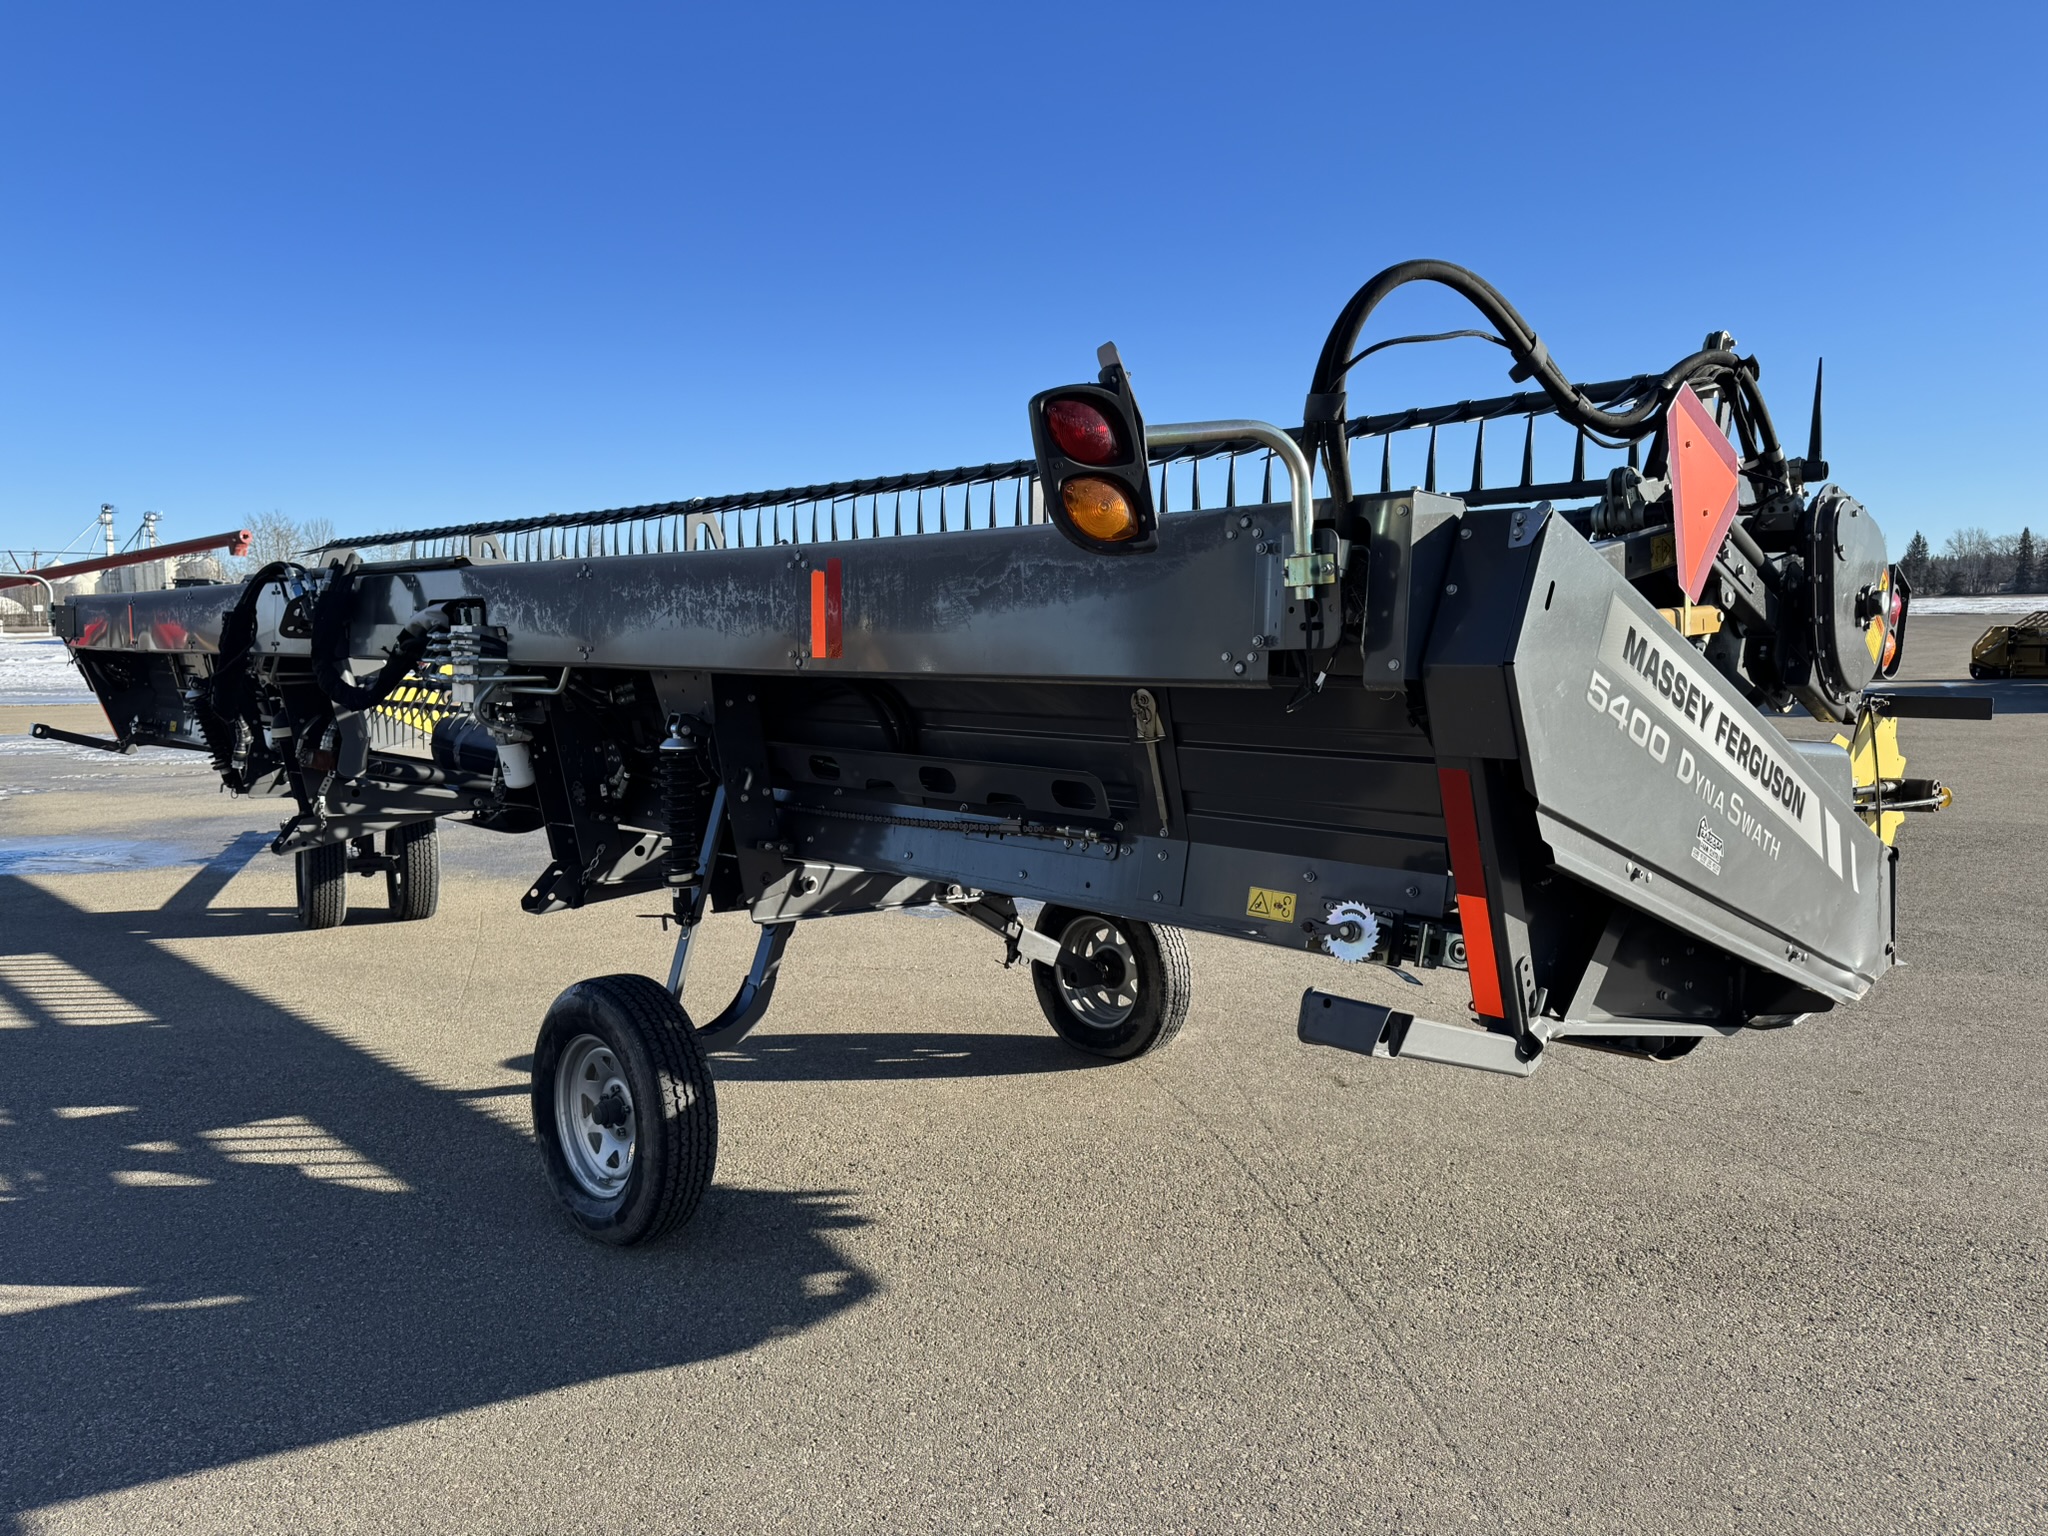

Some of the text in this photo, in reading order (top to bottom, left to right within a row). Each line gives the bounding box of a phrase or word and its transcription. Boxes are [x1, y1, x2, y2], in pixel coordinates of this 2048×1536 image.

[1586, 669, 1671, 764] 5400
[1622, 625, 1806, 823] MASSEY FERGUSON
